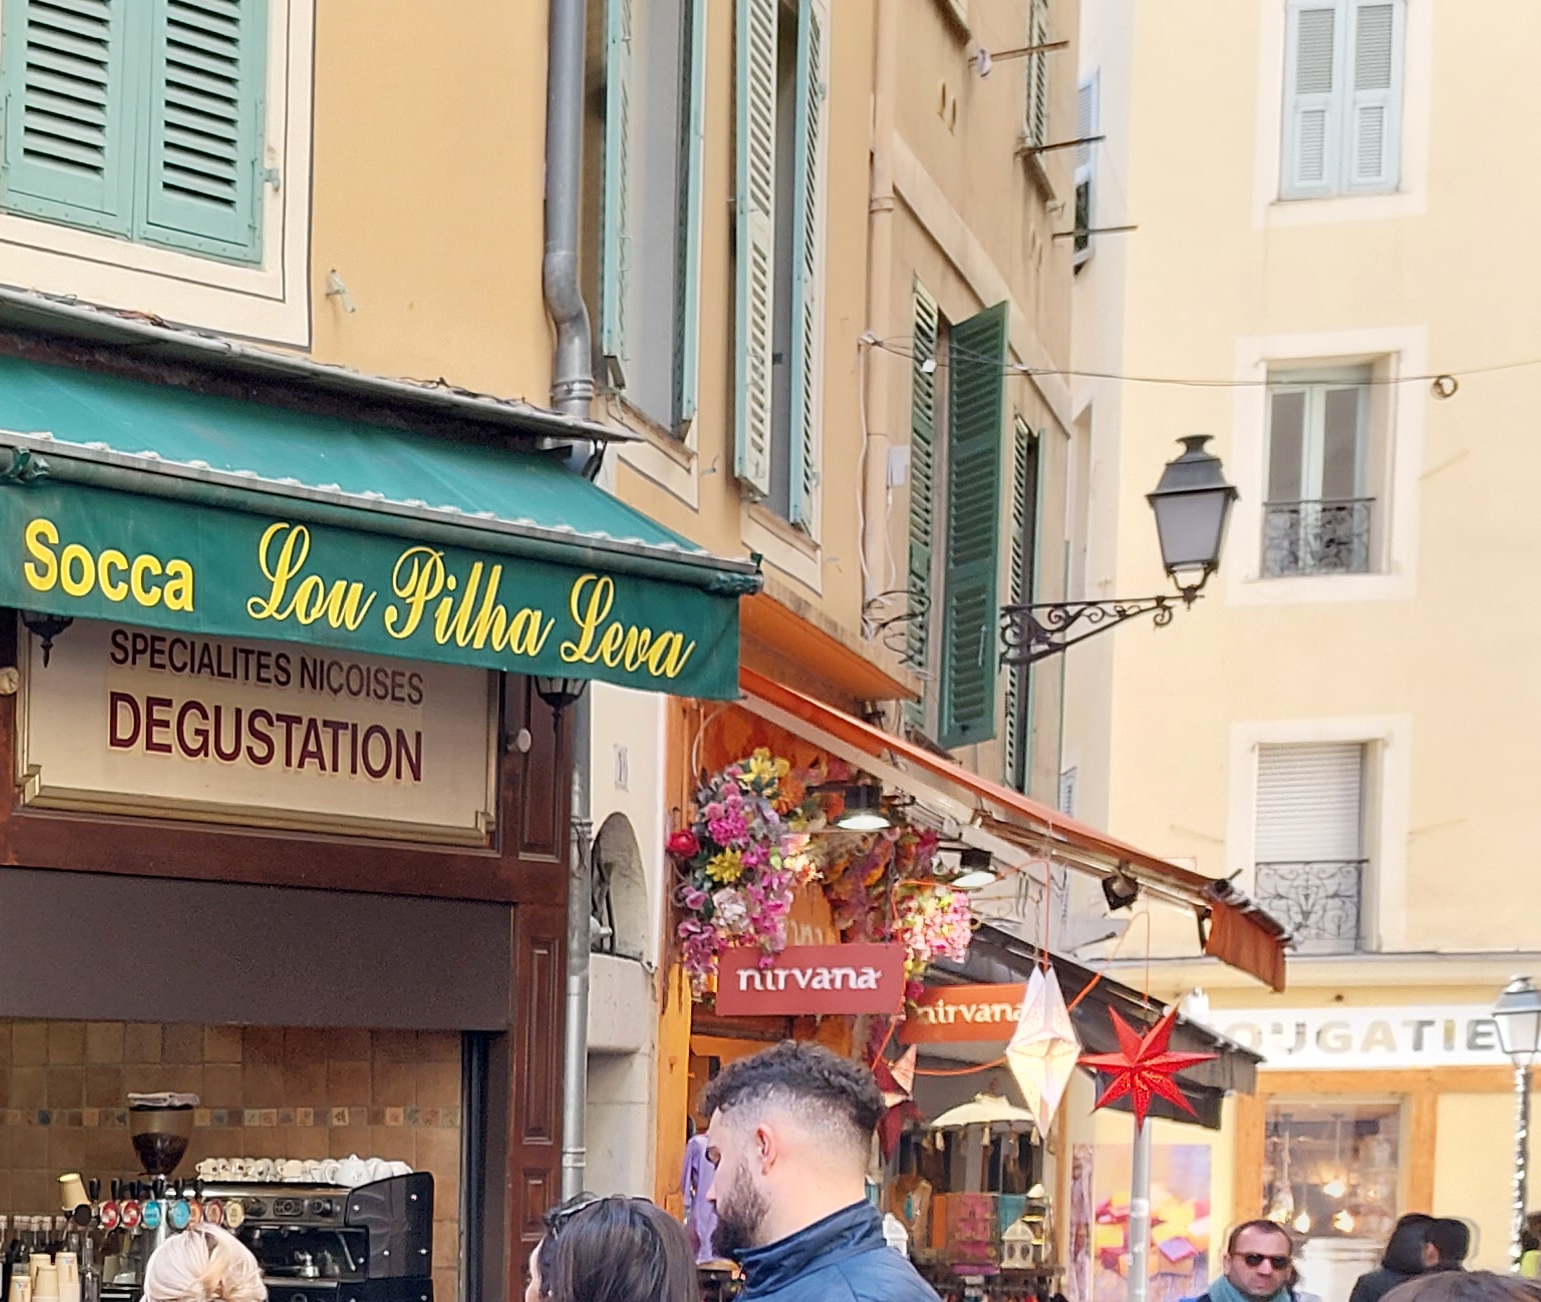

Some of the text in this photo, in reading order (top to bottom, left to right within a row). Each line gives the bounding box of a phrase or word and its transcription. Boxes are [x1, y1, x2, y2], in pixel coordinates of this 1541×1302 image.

[23, 517, 195, 613] Socca
[247, 520, 698, 679] Lou Pilha Leva
[110, 629, 423, 705] SPECIALITES NIÇOISES
[109, 691, 422, 782] DEGUSTATION
[736, 964, 883, 992] nirvana
[1224, 1018, 1498, 1054] OUGATIE
